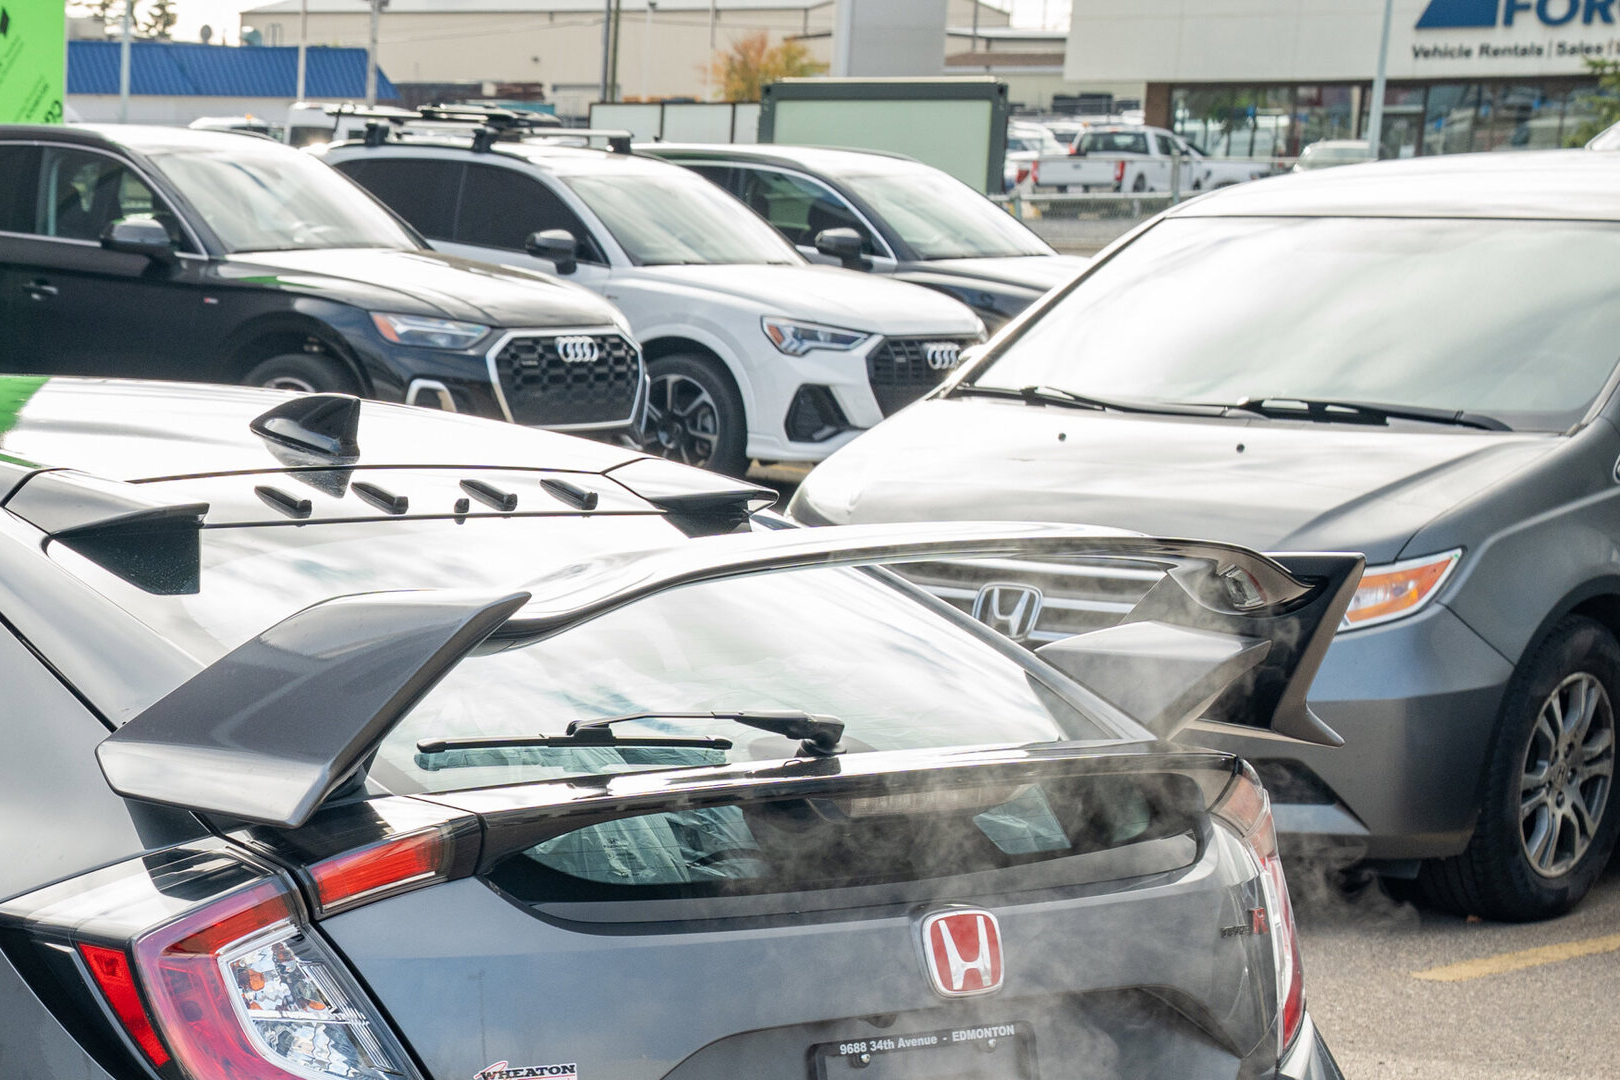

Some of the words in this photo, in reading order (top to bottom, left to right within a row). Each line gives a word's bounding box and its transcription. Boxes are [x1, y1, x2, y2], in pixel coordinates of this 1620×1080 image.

[1502, 0, 1620, 27] FOR
[1412, 43, 1473, 58] Vehicle
[1479, 42, 1543, 57] Rentals
[1556, 41, 1603, 57] Sales
[839, 1042, 867, 1055] 9688
[869, 1038, 895, 1051] 34th
[897, 1035, 938, 1049] Avenue
[952, 1024, 1015, 1042] EDMONTON
[480, 1064, 576, 1080] WHEATON
